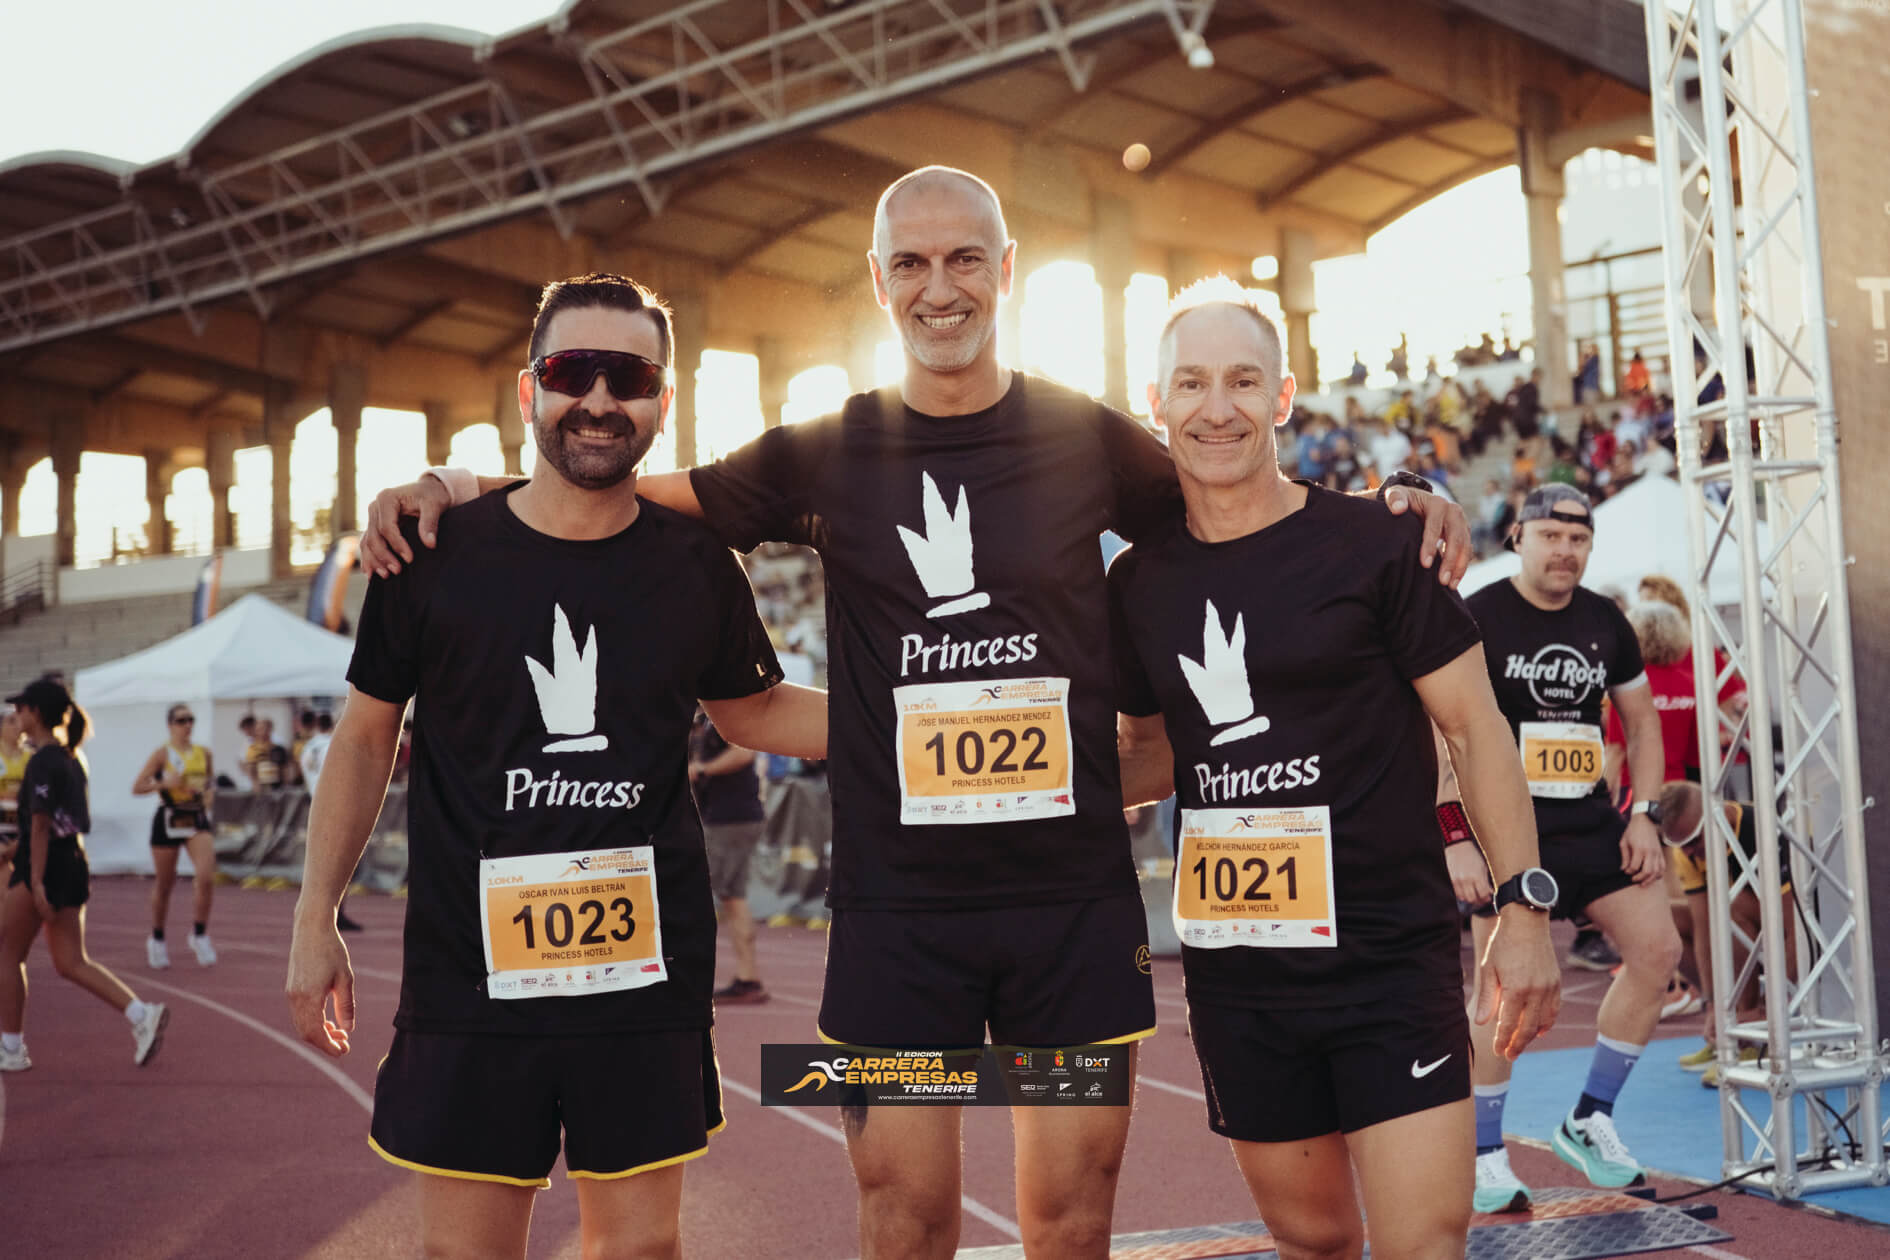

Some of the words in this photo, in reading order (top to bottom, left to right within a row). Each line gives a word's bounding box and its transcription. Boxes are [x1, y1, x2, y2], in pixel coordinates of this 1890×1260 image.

[901, 633, 1038, 677] Princess
[1505, 654, 1561, 681] Hard
[1561, 658, 1607, 689] Rock
[1544, 687, 1575, 699] HOTEL
[917, 718, 937, 727] JOSE
[938, 716, 970, 726] MANUEL
[926, 727, 1048, 776] 1022
[1536, 748, 1595, 773] 1003
[952, 777, 993, 788] PRINCESS
[994, 775, 1026, 786] HOTELS
[1193, 755, 1320, 803] Princess
[505, 768, 645, 811] Princess
[1247, 814, 1304, 822] CARRERA
[582, 853, 634, 864] CARRERA
[1193, 857, 1297, 901] 1021
[519, 888, 549, 899] OSCAR
[571, 886, 590, 895] LUIS
[1210, 904, 1247, 913] PRINCESS
[1248, 904, 1279, 913] HOTELS
[513, 897, 636, 949] 1023
[541, 951, 582, 961] PRINCESS
[584, 946, 613, 957] HOTELS
